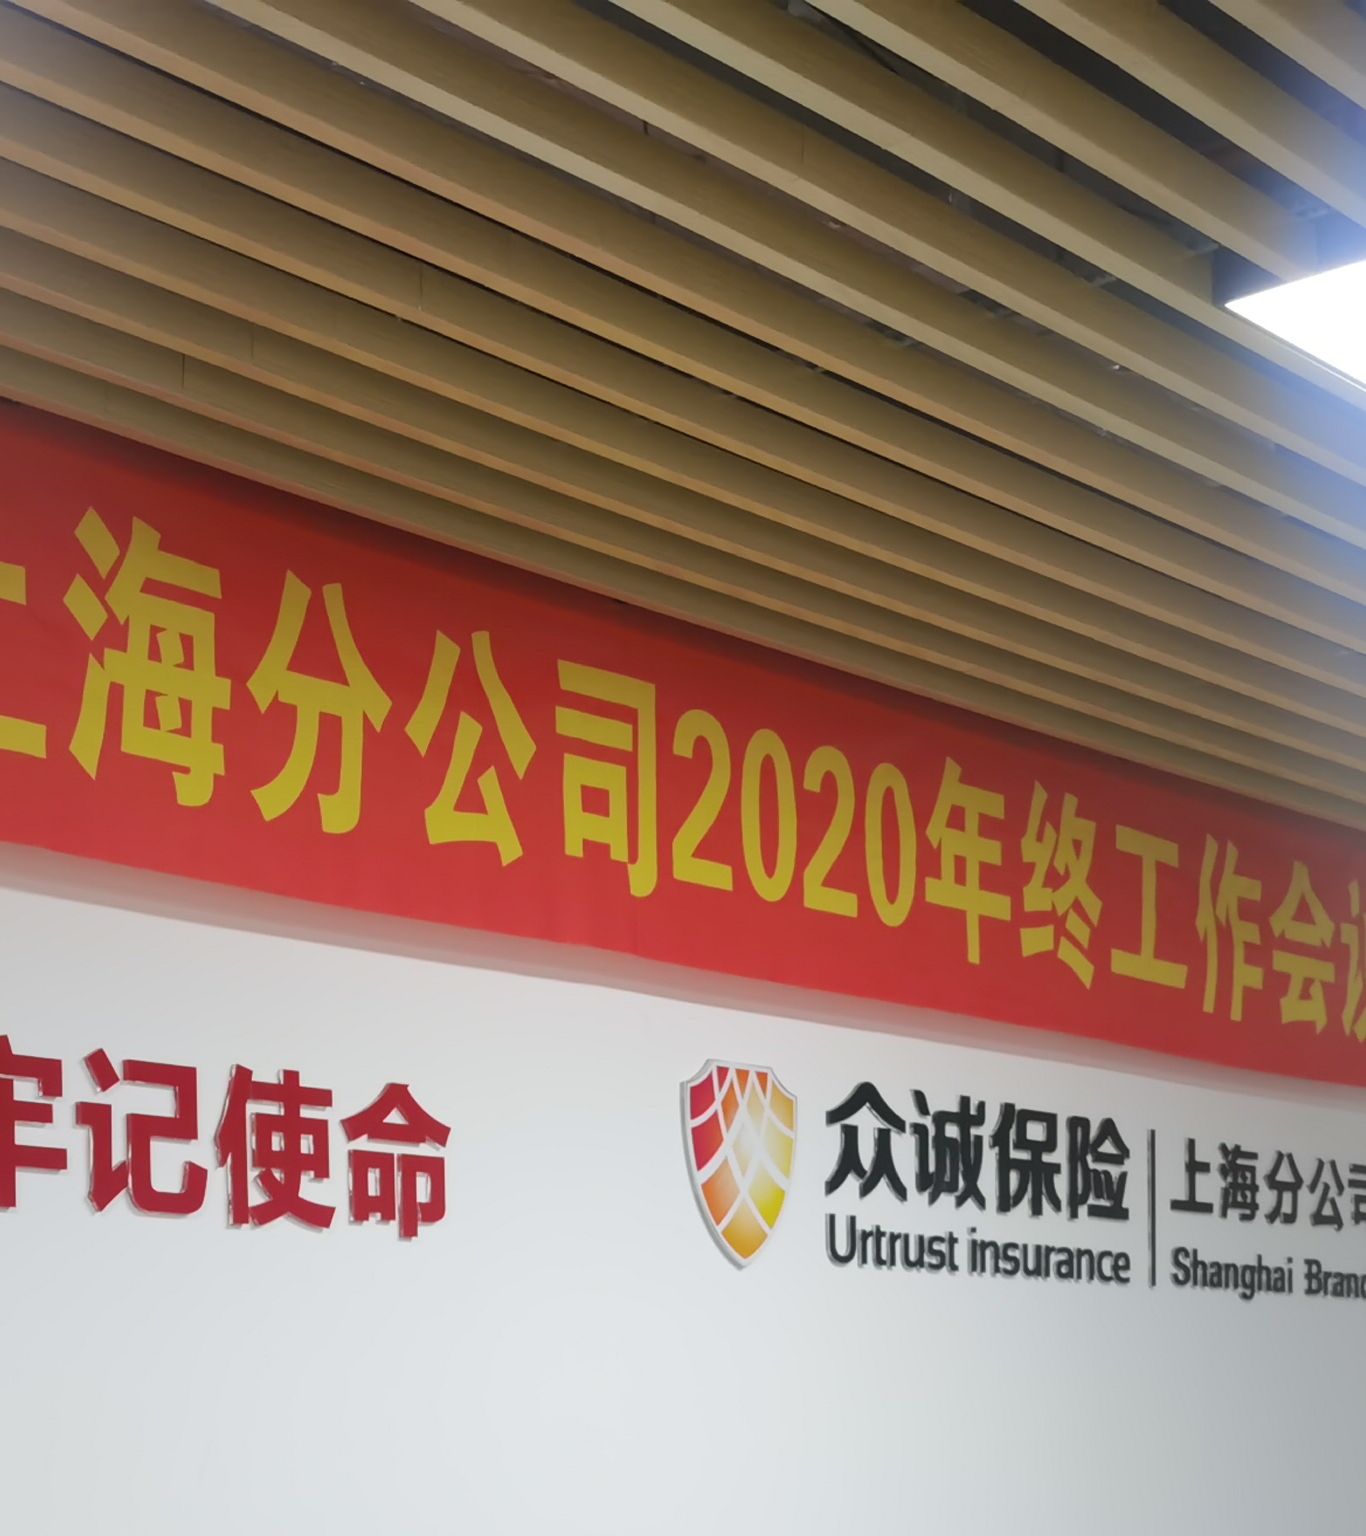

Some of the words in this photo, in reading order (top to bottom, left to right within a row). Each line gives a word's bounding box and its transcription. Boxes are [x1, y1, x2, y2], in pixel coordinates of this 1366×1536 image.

[825, 1081, 1131, 1221] 众诚保险
[825, 1212, 959, 1273] Urtrust
[966, 1226, 1131, 1284] insurance
[1171, 1245, 1294, 1302] Shanghai
